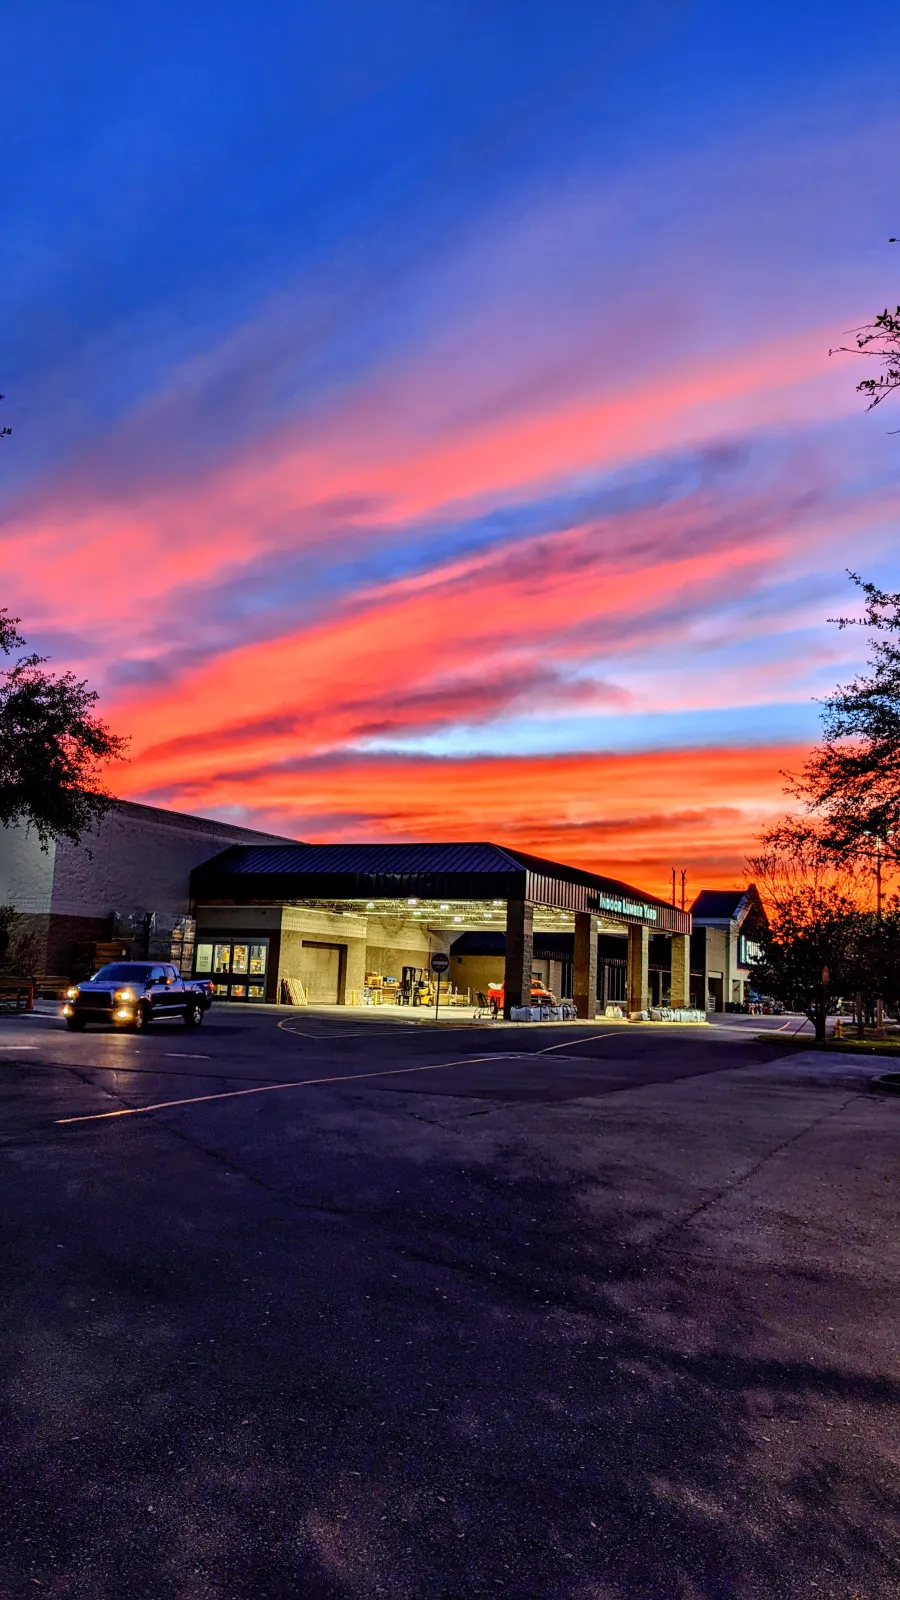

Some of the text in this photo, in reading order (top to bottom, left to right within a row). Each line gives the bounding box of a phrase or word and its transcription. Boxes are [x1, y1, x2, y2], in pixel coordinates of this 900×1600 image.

[599, 893, 656, 920] INDOOR LUMBER YARD
